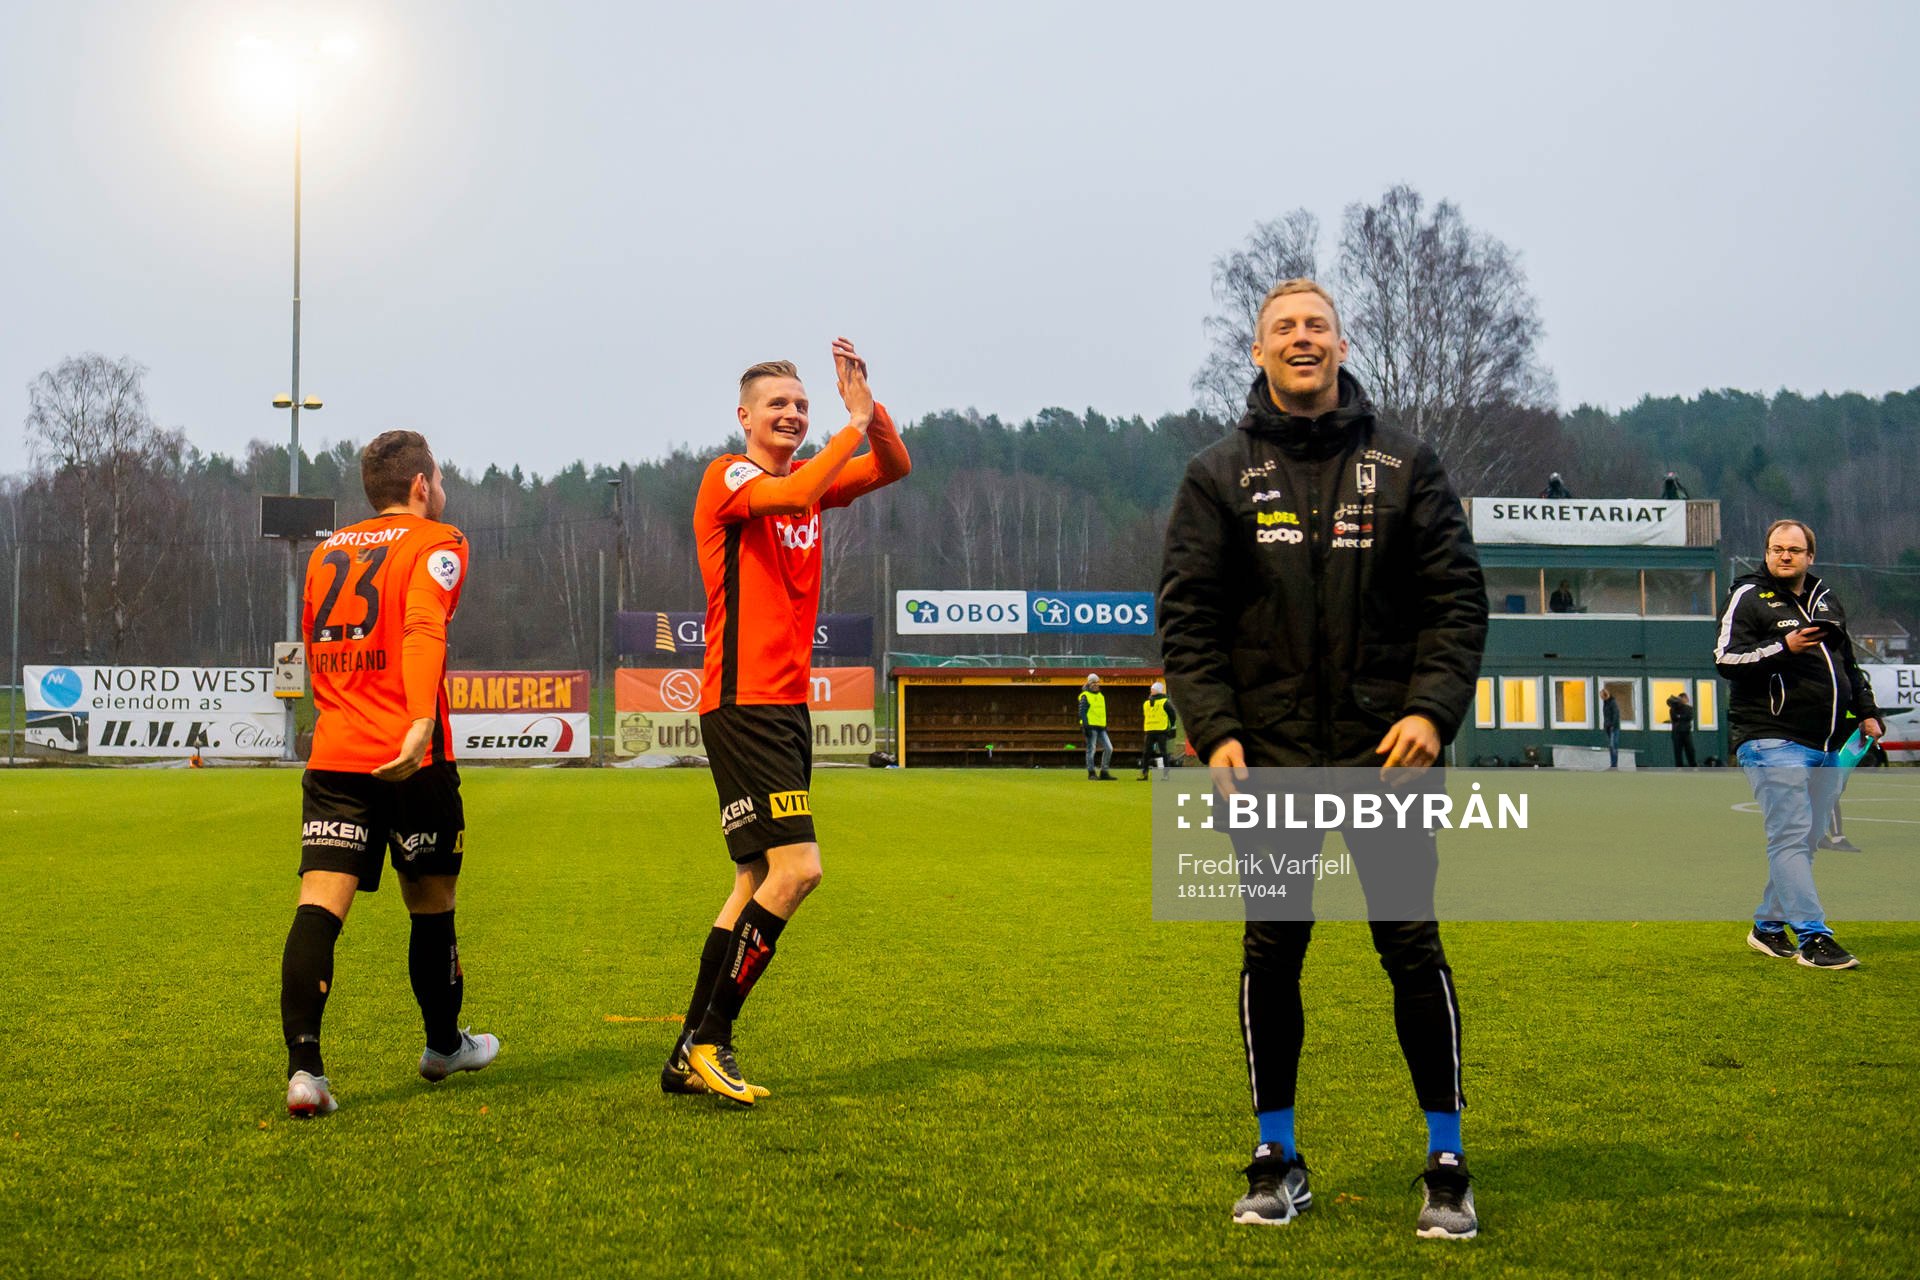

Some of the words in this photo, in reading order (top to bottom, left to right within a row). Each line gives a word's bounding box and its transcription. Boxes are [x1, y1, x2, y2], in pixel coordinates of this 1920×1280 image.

[1493, 504, 1668, 523] SEKRETARIAT
[323, 528, 410, 550] HORISONT
[311, 546, 390, 643] 23
[946, 604, 1021, 623] OBOS
[1074, 604, 1149, 625] OBOS
[94, 669, 180, 692] NORD
[192, 670, 273, 693] WEST
[92, 695, 190, 710] eiendom
[199, 697, 223, 710] as
[466, 735, 548, 749] SELTOR
